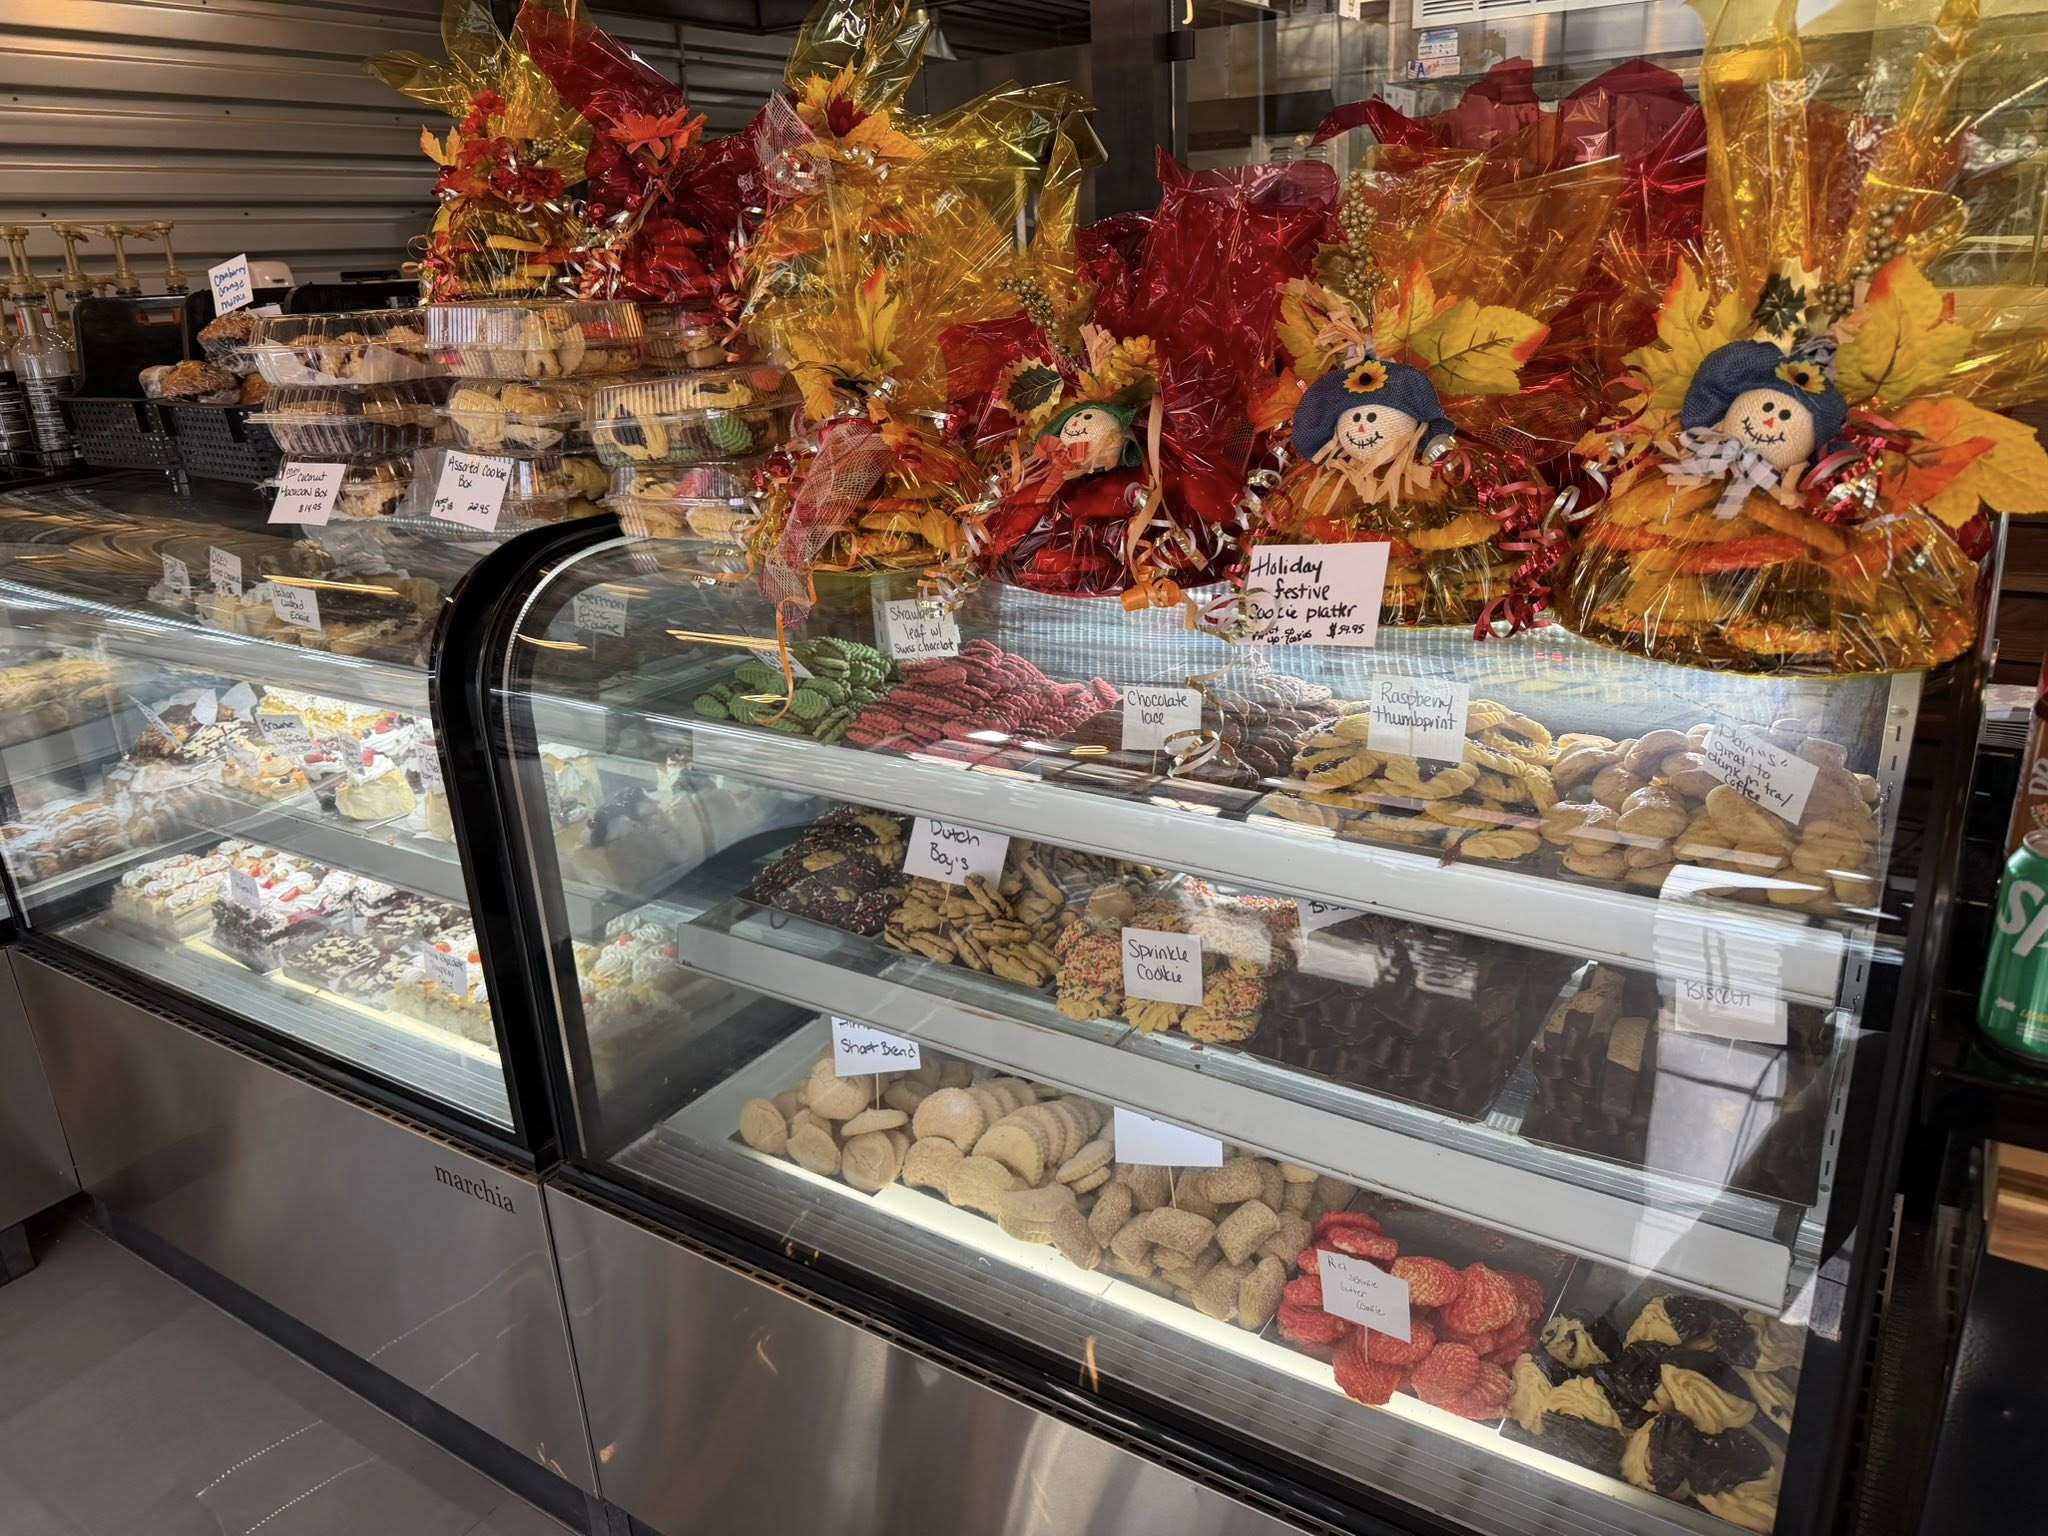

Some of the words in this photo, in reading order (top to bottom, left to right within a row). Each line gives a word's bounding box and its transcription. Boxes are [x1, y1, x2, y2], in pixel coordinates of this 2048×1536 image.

[458, 474, 472, 488] Box
[1251, 552, 1323, 583] Holiday
[1127, 690, 1189, 708] Chocolate
[930, 819, 980, 847] Dutch
[1128, 938, 1190, 964] Sprinkle
[1136, 963, 1183, 984] Cookie
[433, 1164, 517, 1216] marchia
